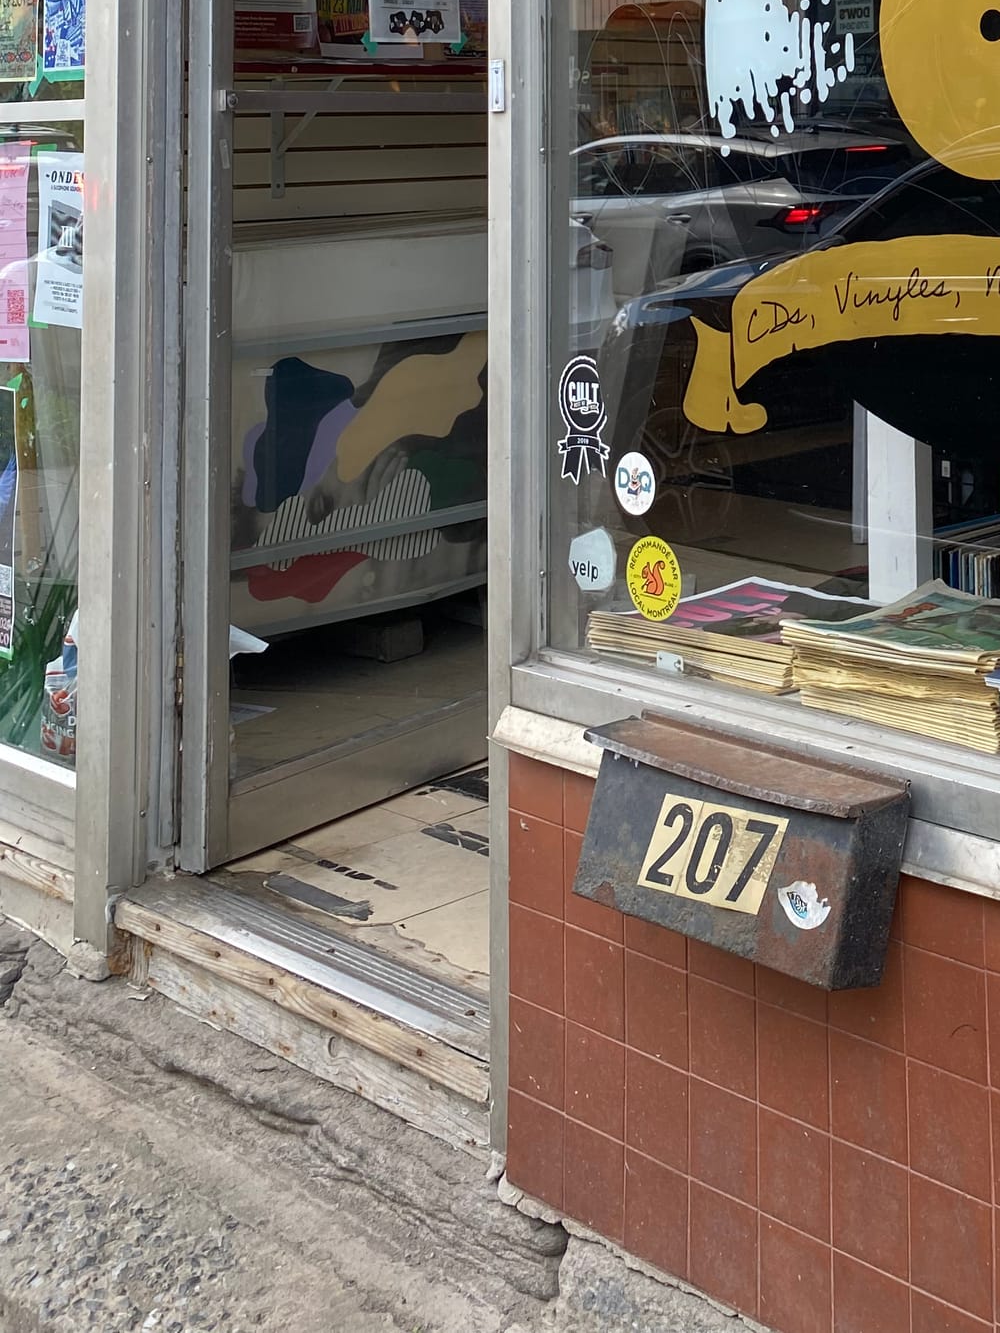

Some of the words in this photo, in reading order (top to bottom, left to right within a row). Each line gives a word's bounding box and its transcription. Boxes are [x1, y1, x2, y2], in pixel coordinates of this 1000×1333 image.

[746, 298, 817, 347] CDs,
[834, 266, 962, 322] Vinyles,
[571, 560, 600, 582] yelp
[629, 541, 671, 570] RECOMMANDÉ
[668, 560, 679, 581] PAR
[629, 581, 646, 612] LOCAL
[646, 591, 679, 618] MONTRÉAL
[645, 802, 779, 903] 207
